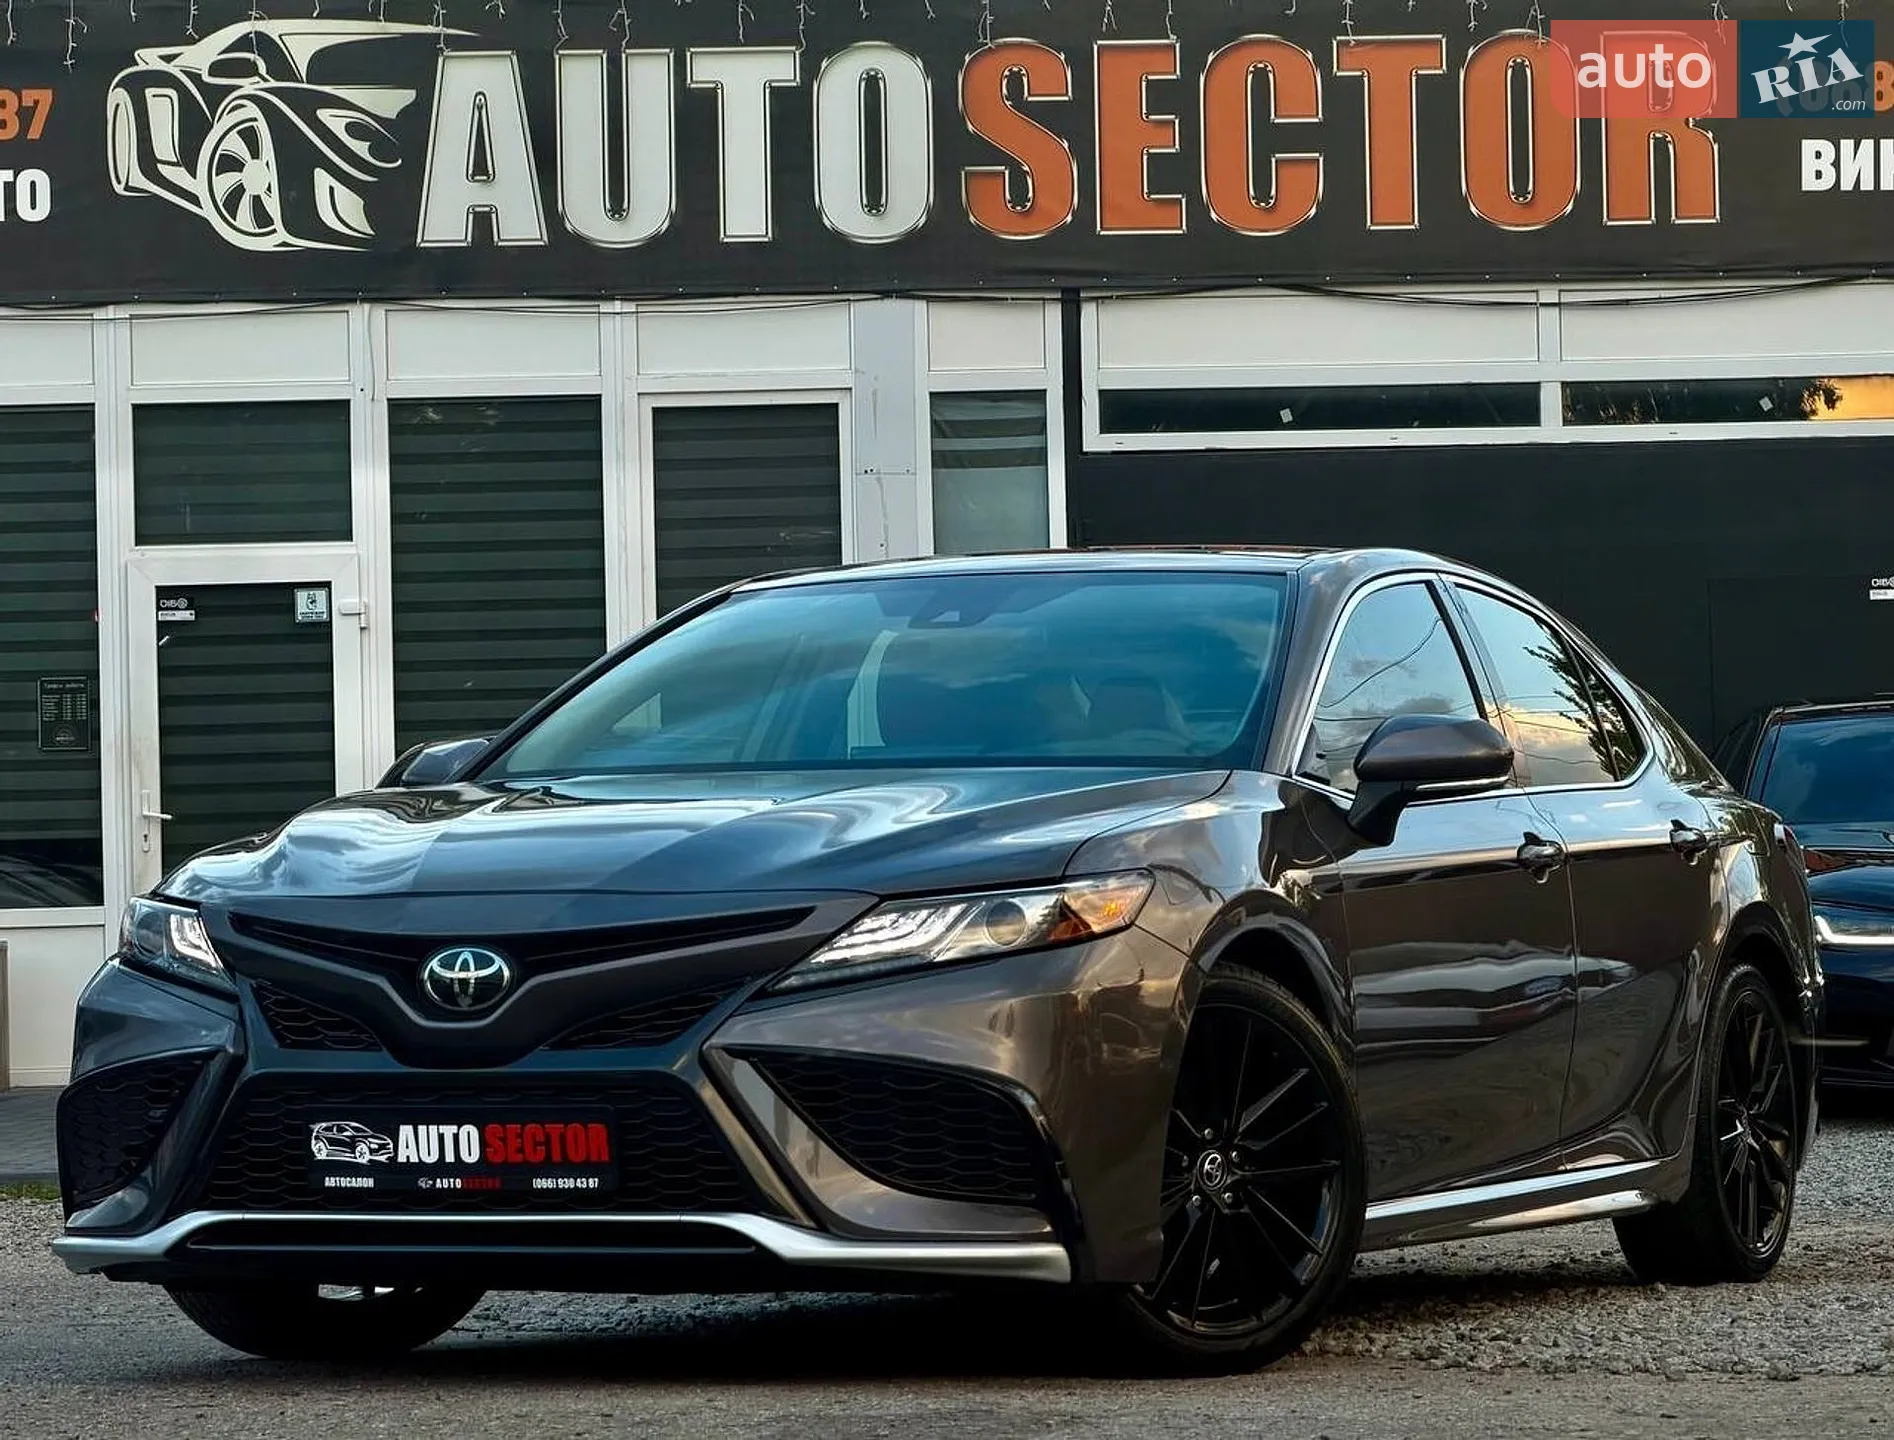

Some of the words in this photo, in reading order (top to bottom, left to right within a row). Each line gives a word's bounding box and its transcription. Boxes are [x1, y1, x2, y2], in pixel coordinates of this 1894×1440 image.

[416, 41, 935, 246] AUTO
[958, 26, 1720, 239] SECTOR
[397, 1124, 480, 1164] AUTO
[483, 1123, 610, 1163] SECTOR
[435, 1177, 462, 1189] AUTO
